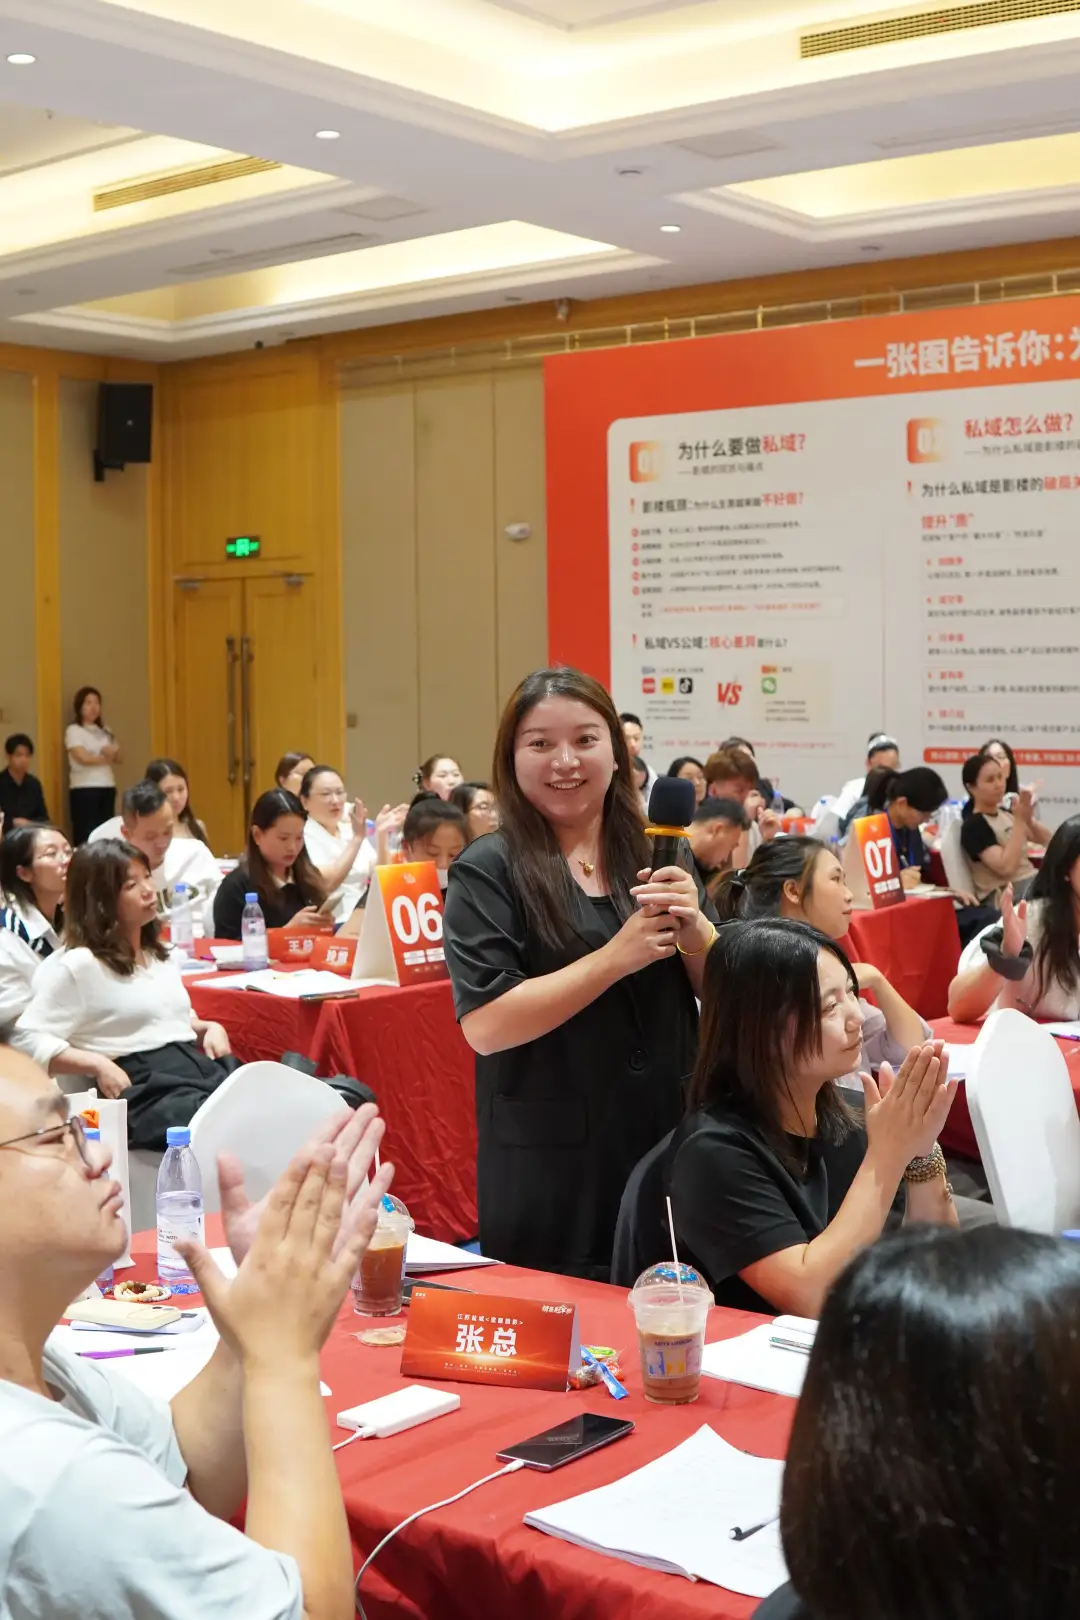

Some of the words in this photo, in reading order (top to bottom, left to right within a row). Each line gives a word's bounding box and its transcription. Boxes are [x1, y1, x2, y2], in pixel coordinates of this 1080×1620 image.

[964, 413, 1073, 438] 私域怎么做?
[678, 432, 807, 461] 为什么要做私域?
[864, 837, 893, 878] 07
[391, 892, 443, 945] 06
[455, 1324, 517, 1357] 张总
